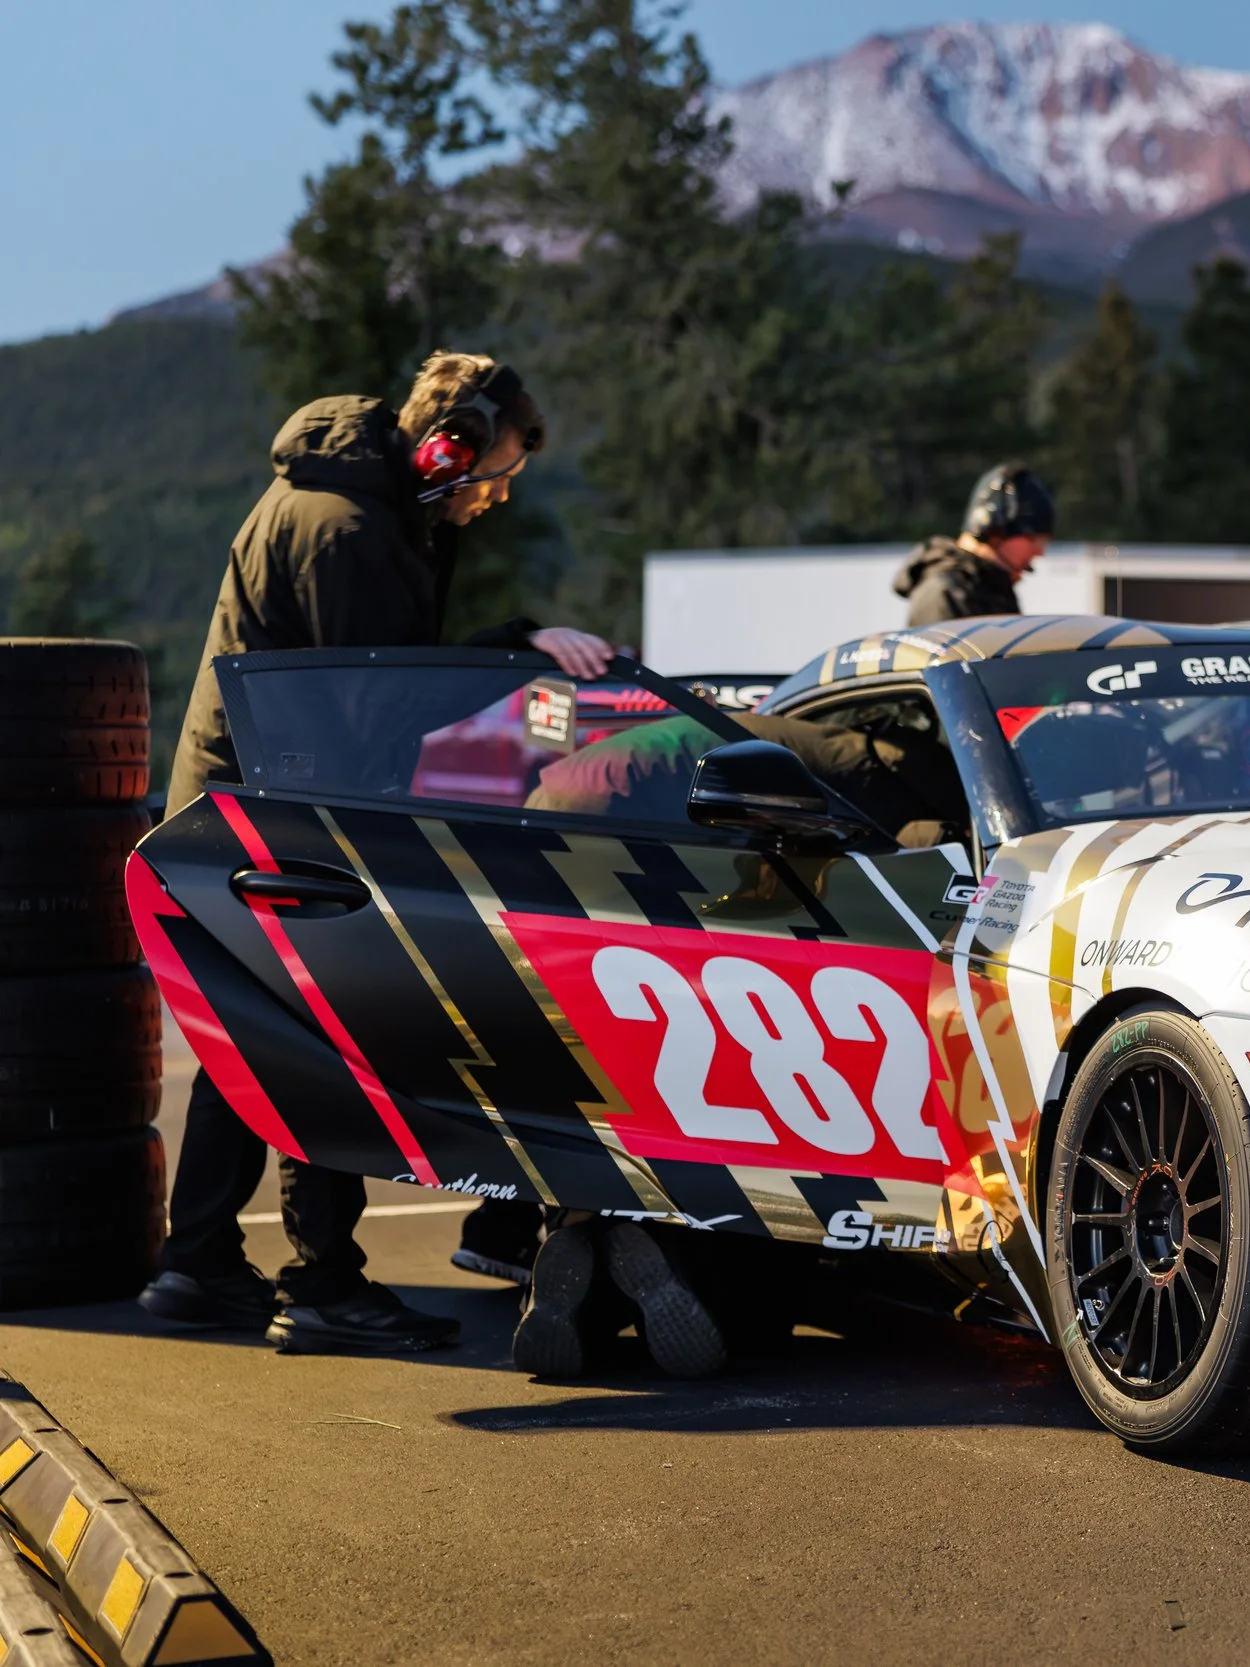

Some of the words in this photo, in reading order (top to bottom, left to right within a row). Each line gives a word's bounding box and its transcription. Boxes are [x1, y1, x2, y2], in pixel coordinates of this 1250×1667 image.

[1187, 675, 1223, 686] THE
[1000, 880, 1036, 891] TOYOTA
[993, 889, 1026, 901] GAZOO
[985, 898, 1018, 912] Racing
[979, 916, 1020, 934] Racing
[1081, 939, 1173, 967] ONWARD
[592, 946, 950, 1166] 282
